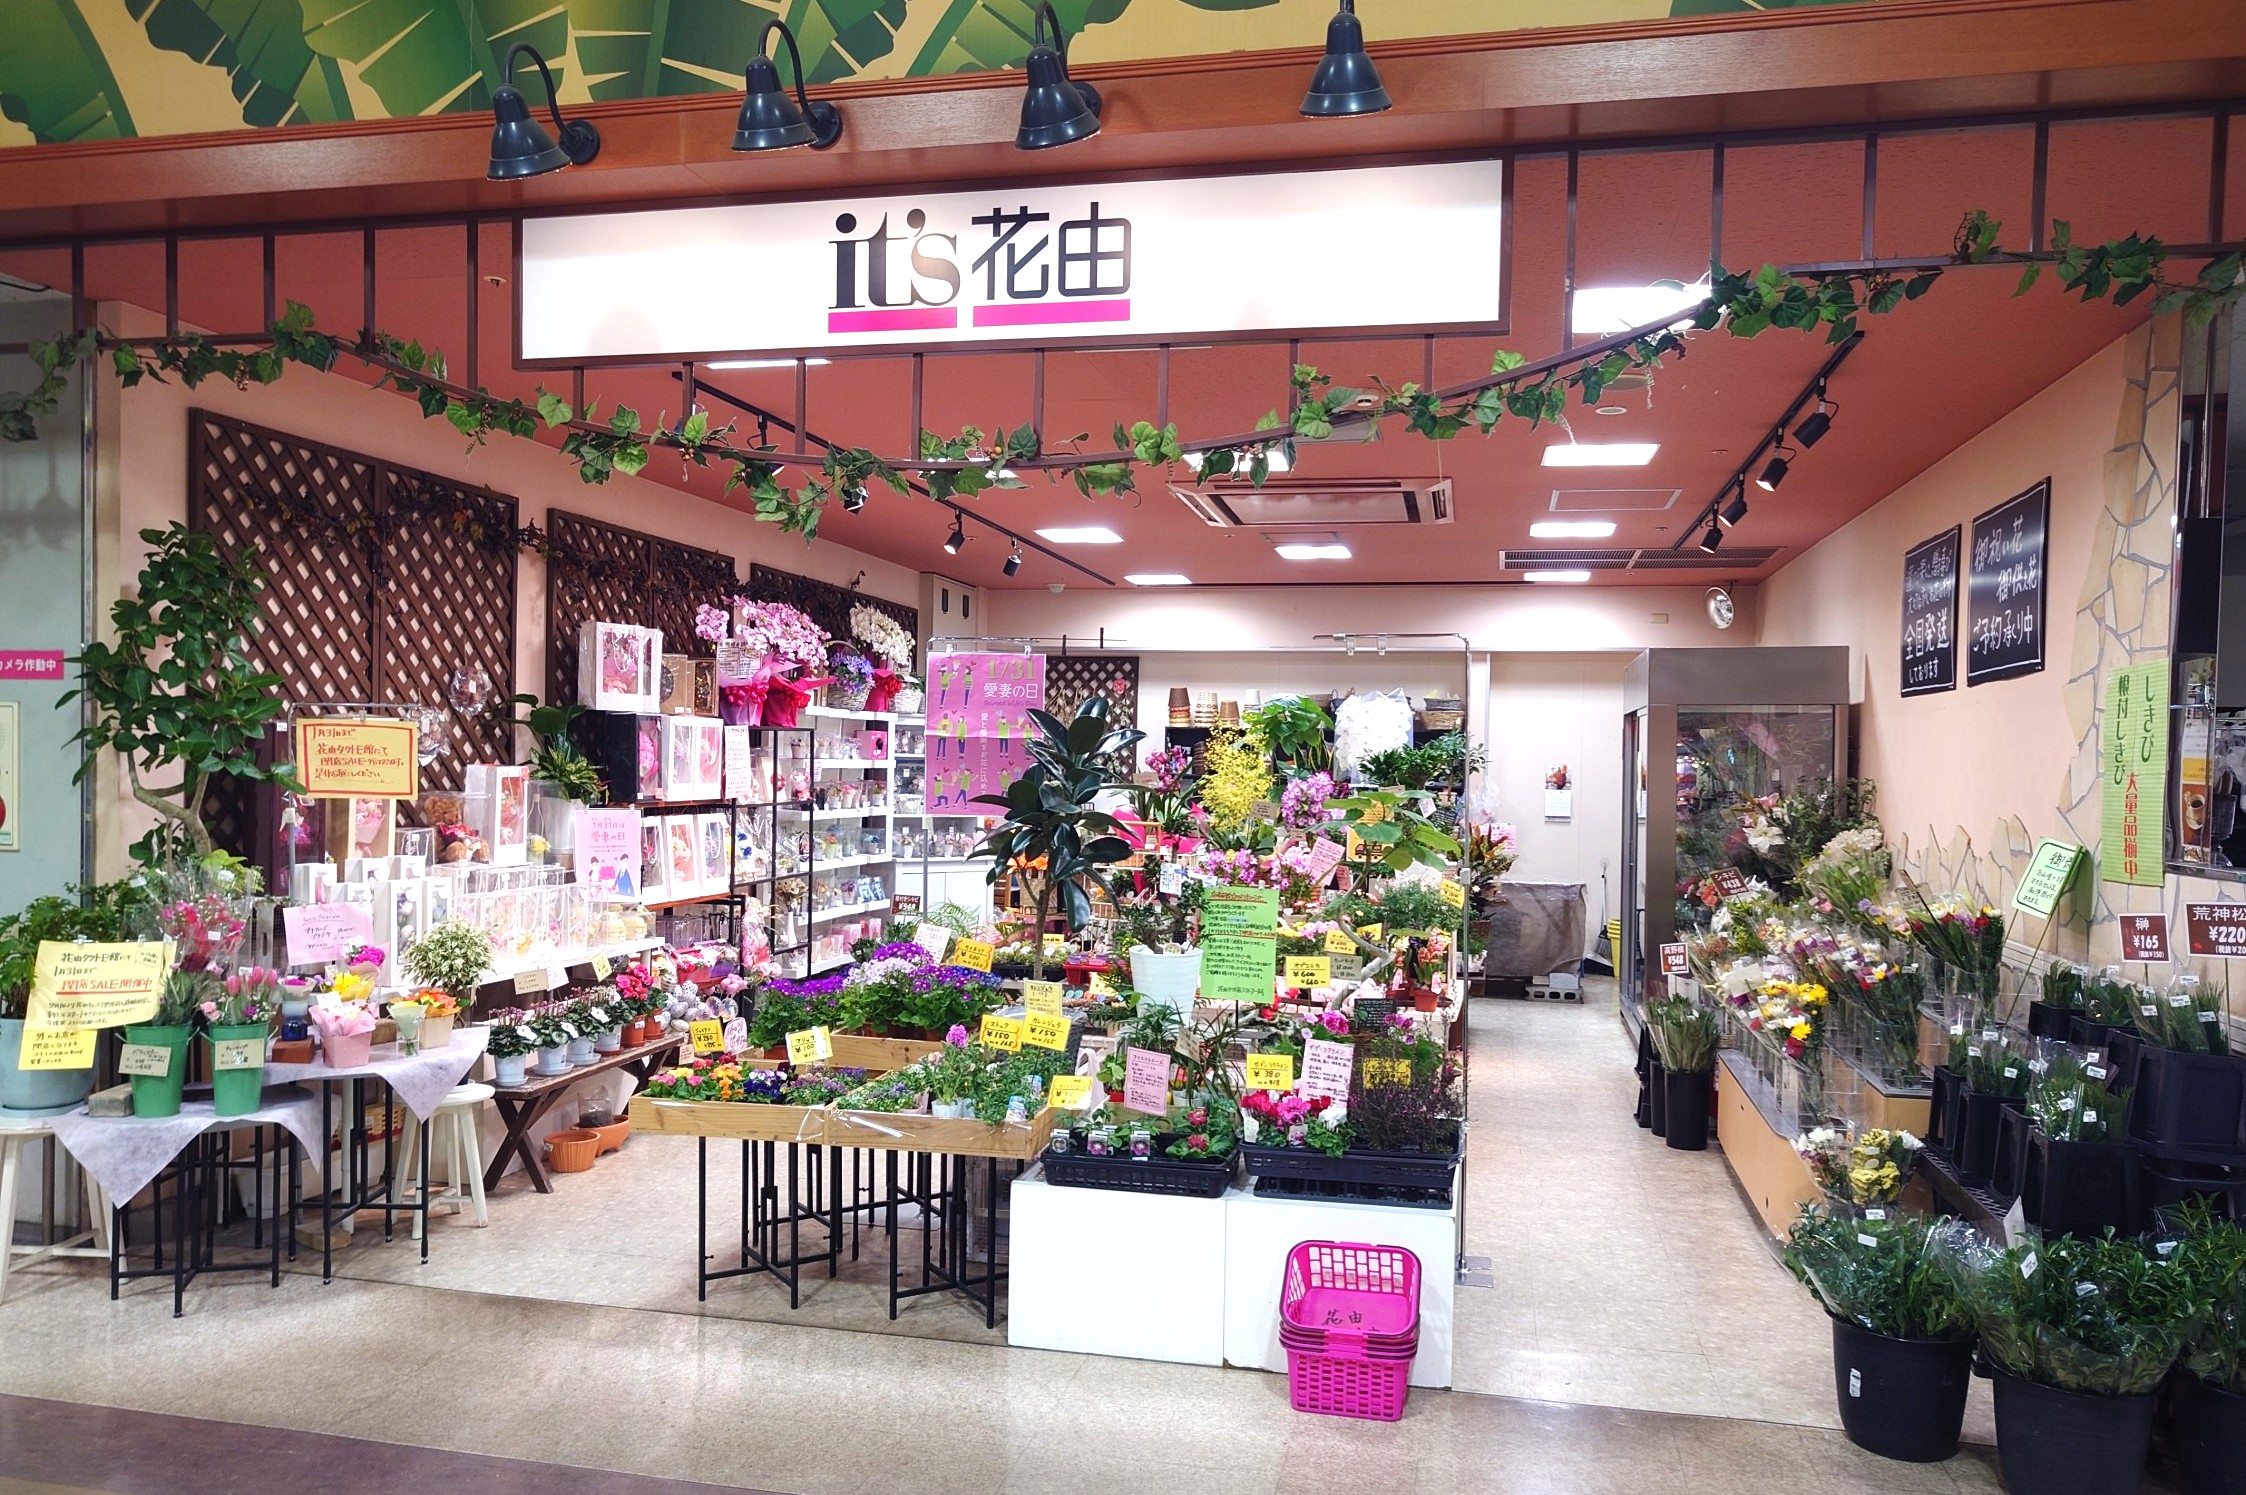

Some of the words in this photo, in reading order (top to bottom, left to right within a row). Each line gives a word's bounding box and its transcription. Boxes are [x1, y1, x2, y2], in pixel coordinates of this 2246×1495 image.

[828, 208, 961, 309] it's
[971, 202, 1132, 300] 花由
[1904, 607, 1950, 661] 全国発送
[987, 659, 1036, 681] 1/31
[1908, 657, 1940, 685] しております
[983, 682, 1038, 699] 愛妻の日
[2141, 675, 2156, 764] しきび
[2114, 674, 2131, 786] 根付しきび
[2123, 772, 2139, 881] 大量品揃中
[1714, 869, 1737, 881] シキビ
[2192, 906, 2246, 923] 荒神松
[2132, 934, 2159, 949] ¥165
[2208, 925, 2246, 944] ¥220
[990, 1021, 1009, 1029] ストック
[1029, 1025, 1057, 1037] ¥150
[986, 1031, 1010, 1040] ¥150
[1253, 1070, 1281, 1078] ¥380
[1321, 1308, 1363, 1325] 花由
